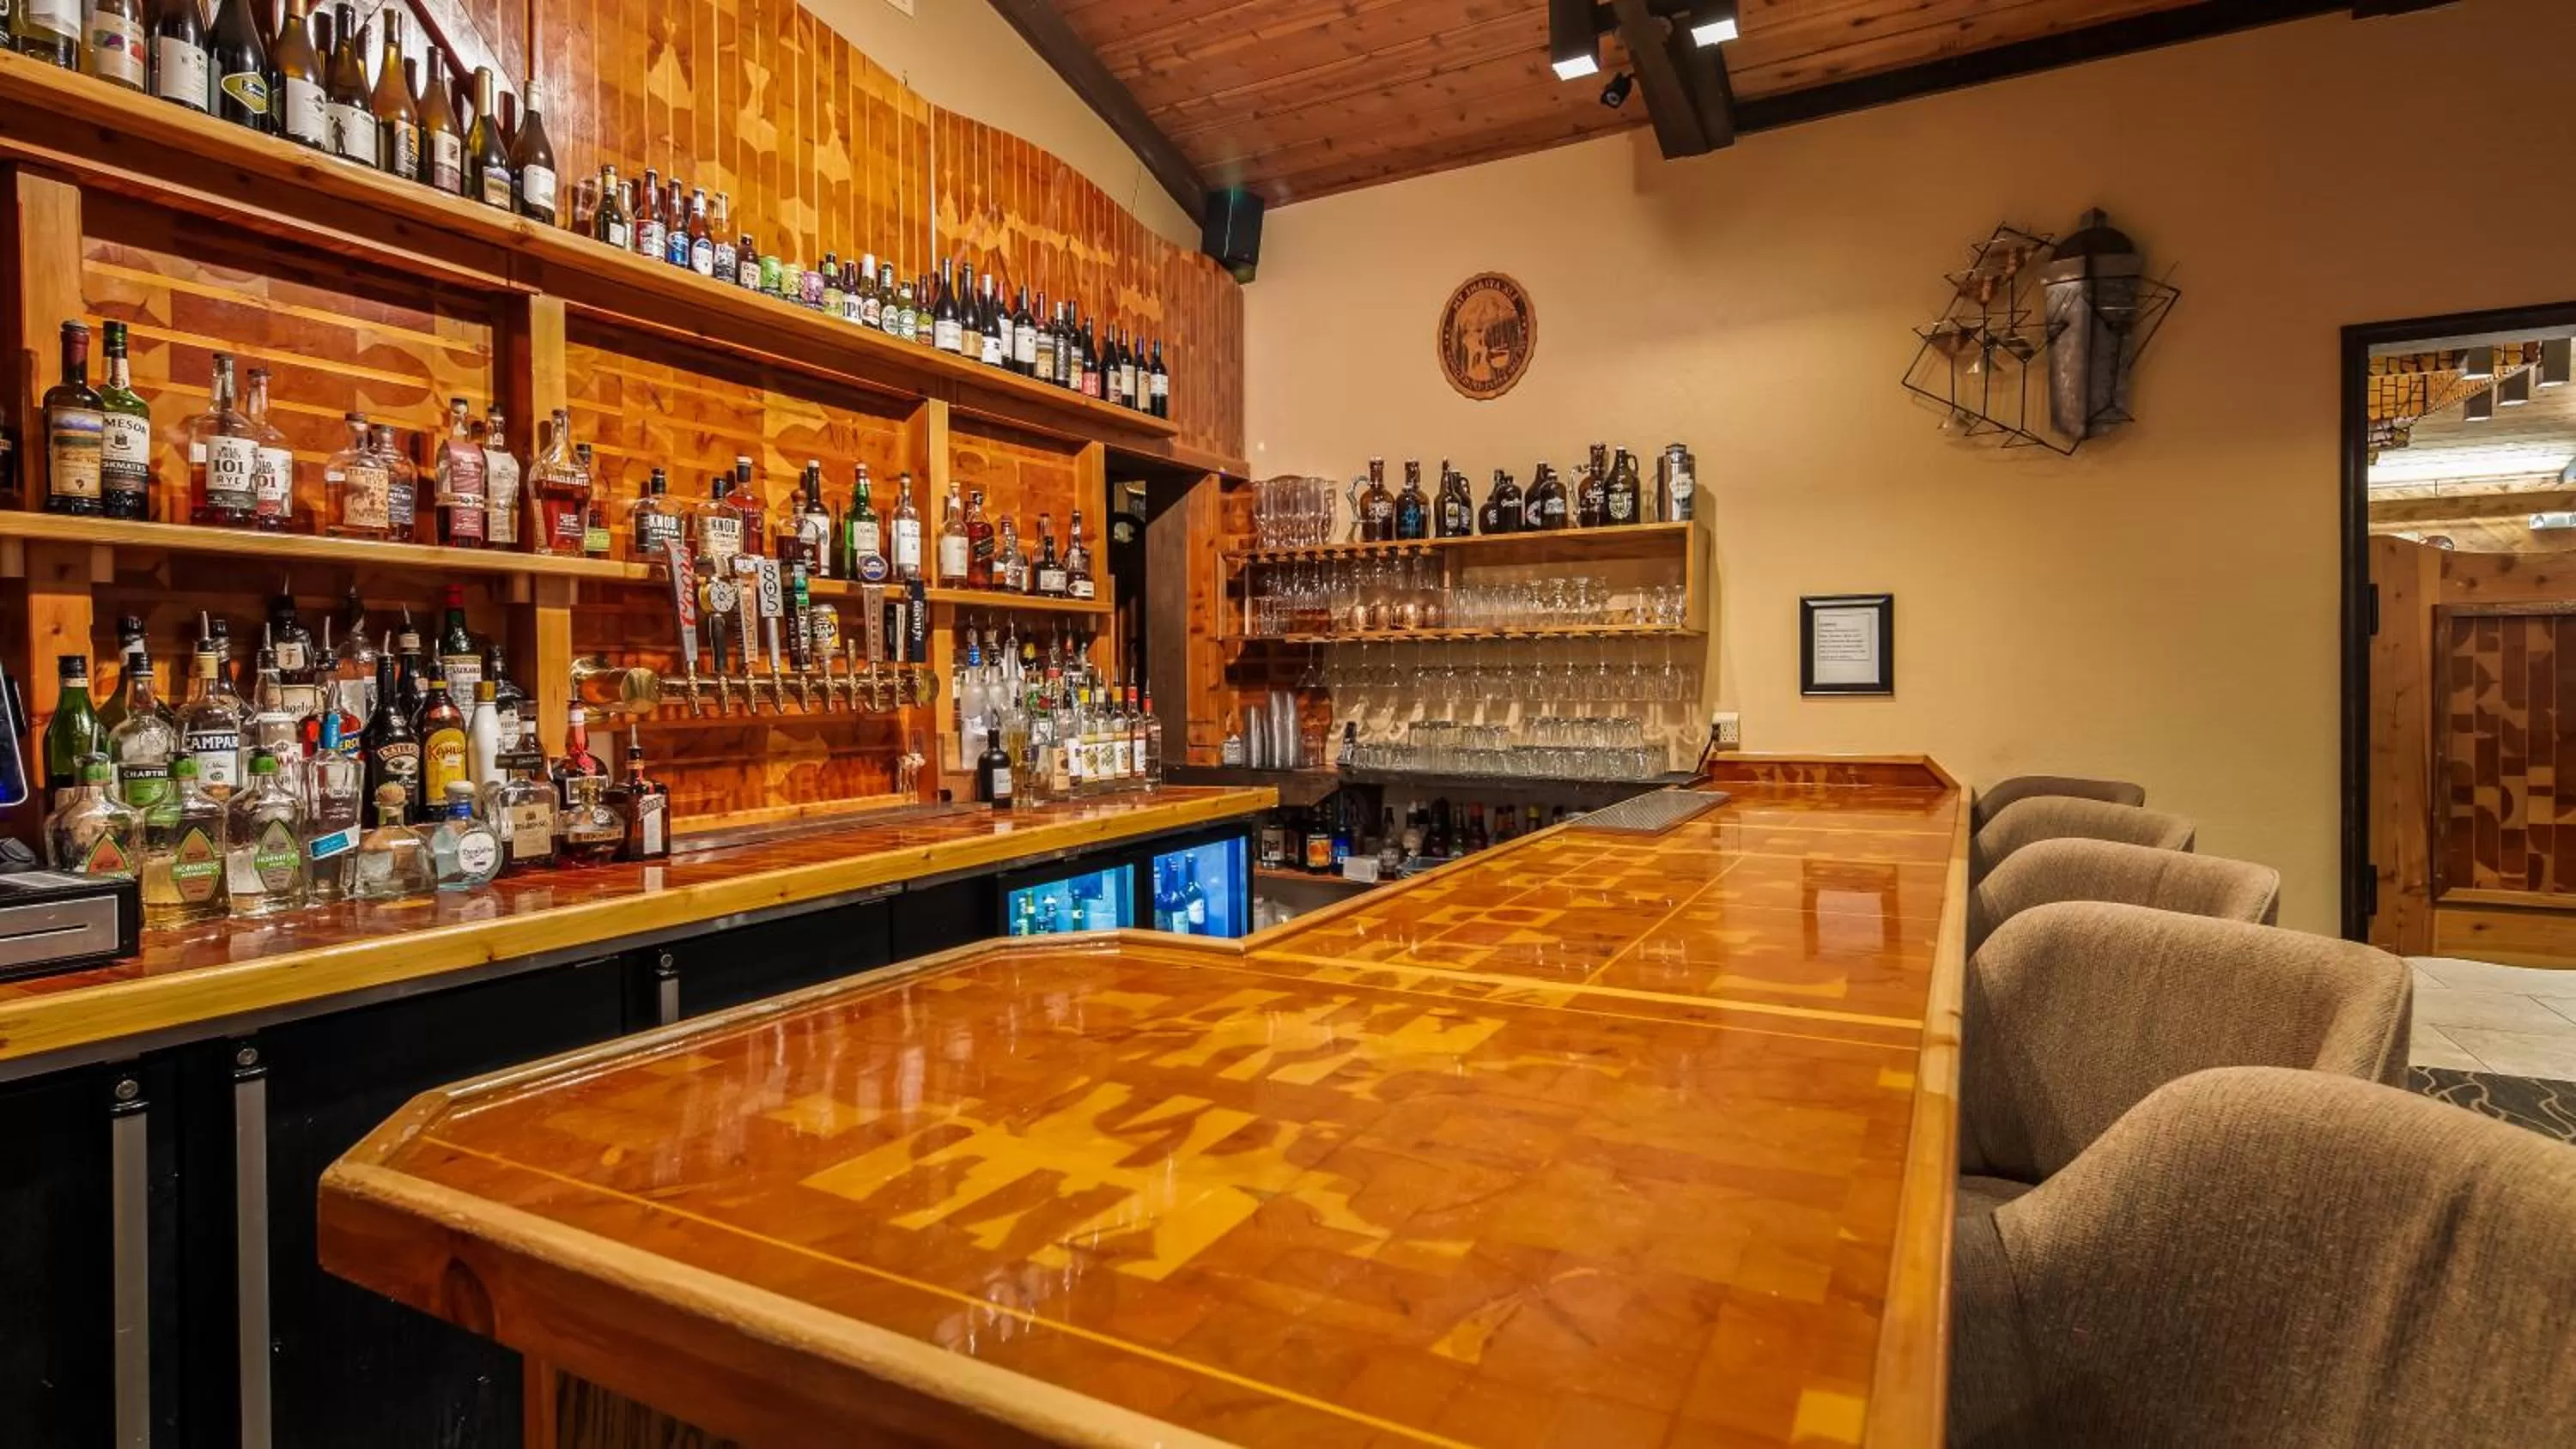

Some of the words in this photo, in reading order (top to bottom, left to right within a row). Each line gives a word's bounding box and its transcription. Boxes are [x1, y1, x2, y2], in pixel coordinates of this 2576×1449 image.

[104, 418, 147, 433] MESON
[103, 462, 147, 472] SKMATES
[213, 459, 245, 474] 101
[216, 476, 240, 485] RYE
[257, 475, 276, 488] 01
[648, 514, 677, 529] KNOB
[710, 518, 736, 533] KNOB
[185, 735, 239, 749] CAMPAR
[338, 739, 359, 749] ERO
[123, 769, 167, 779] CHARTR
